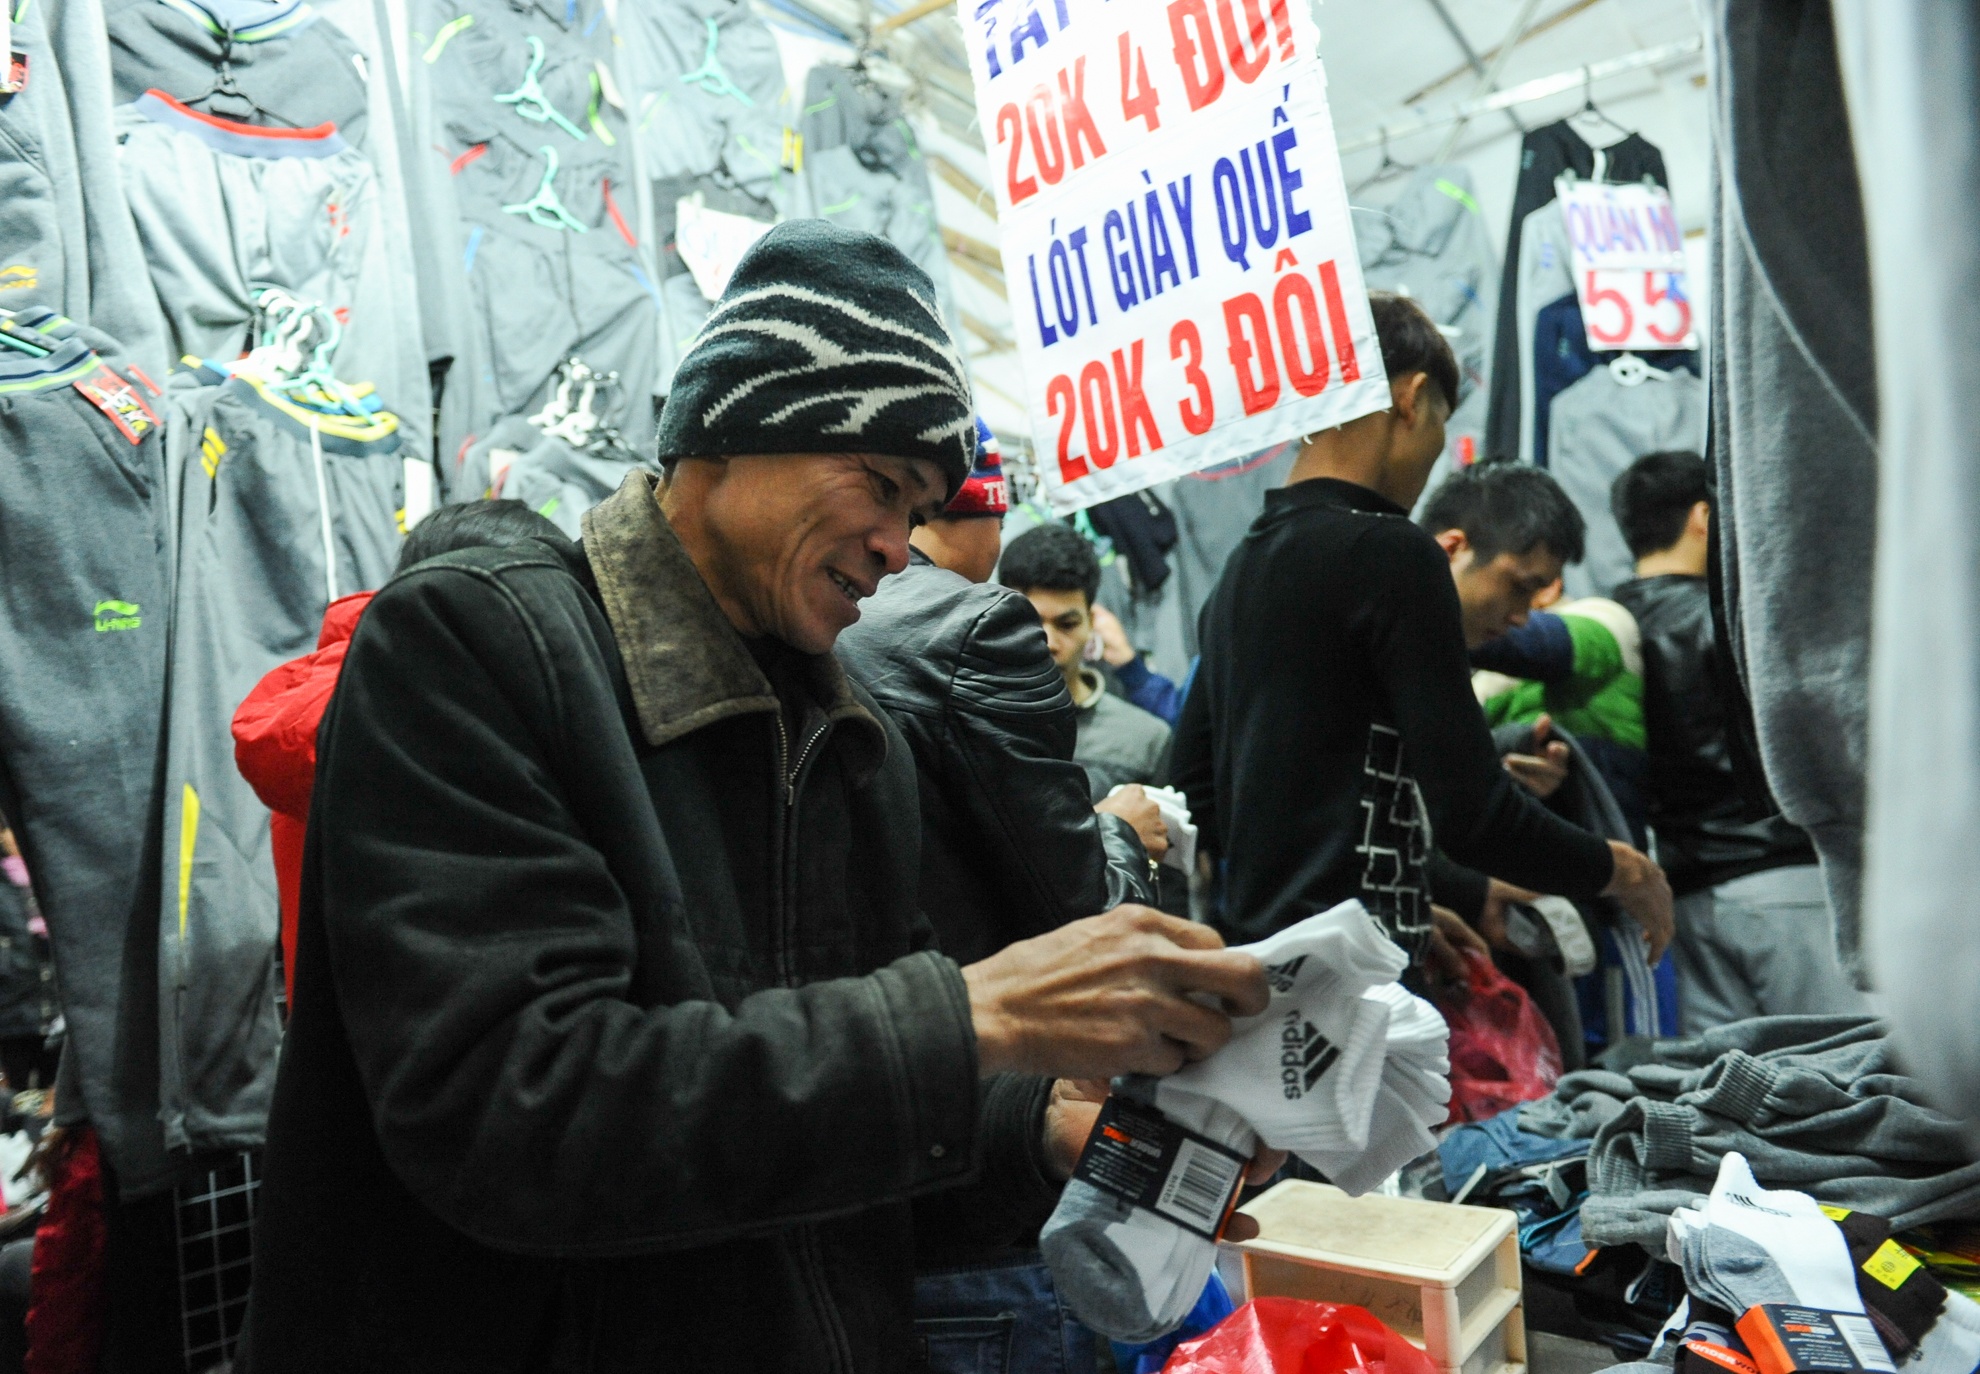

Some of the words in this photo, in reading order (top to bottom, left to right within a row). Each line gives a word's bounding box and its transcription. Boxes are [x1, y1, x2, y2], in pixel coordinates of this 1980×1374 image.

[996, 55, 1107, 206] 20K
[1117, 30, 1160, 133] 4
[1028, 218, 1098, 348] LÓT
[1104, 169, 1200, 312] GIÀY
[1213, 83, 1313, 272] QUẾ
[1046, 338, 1164, 484] 20K
[1169, 319, 1215, 436] 3
[1222, 247, 1361, 417] ĐÔI
